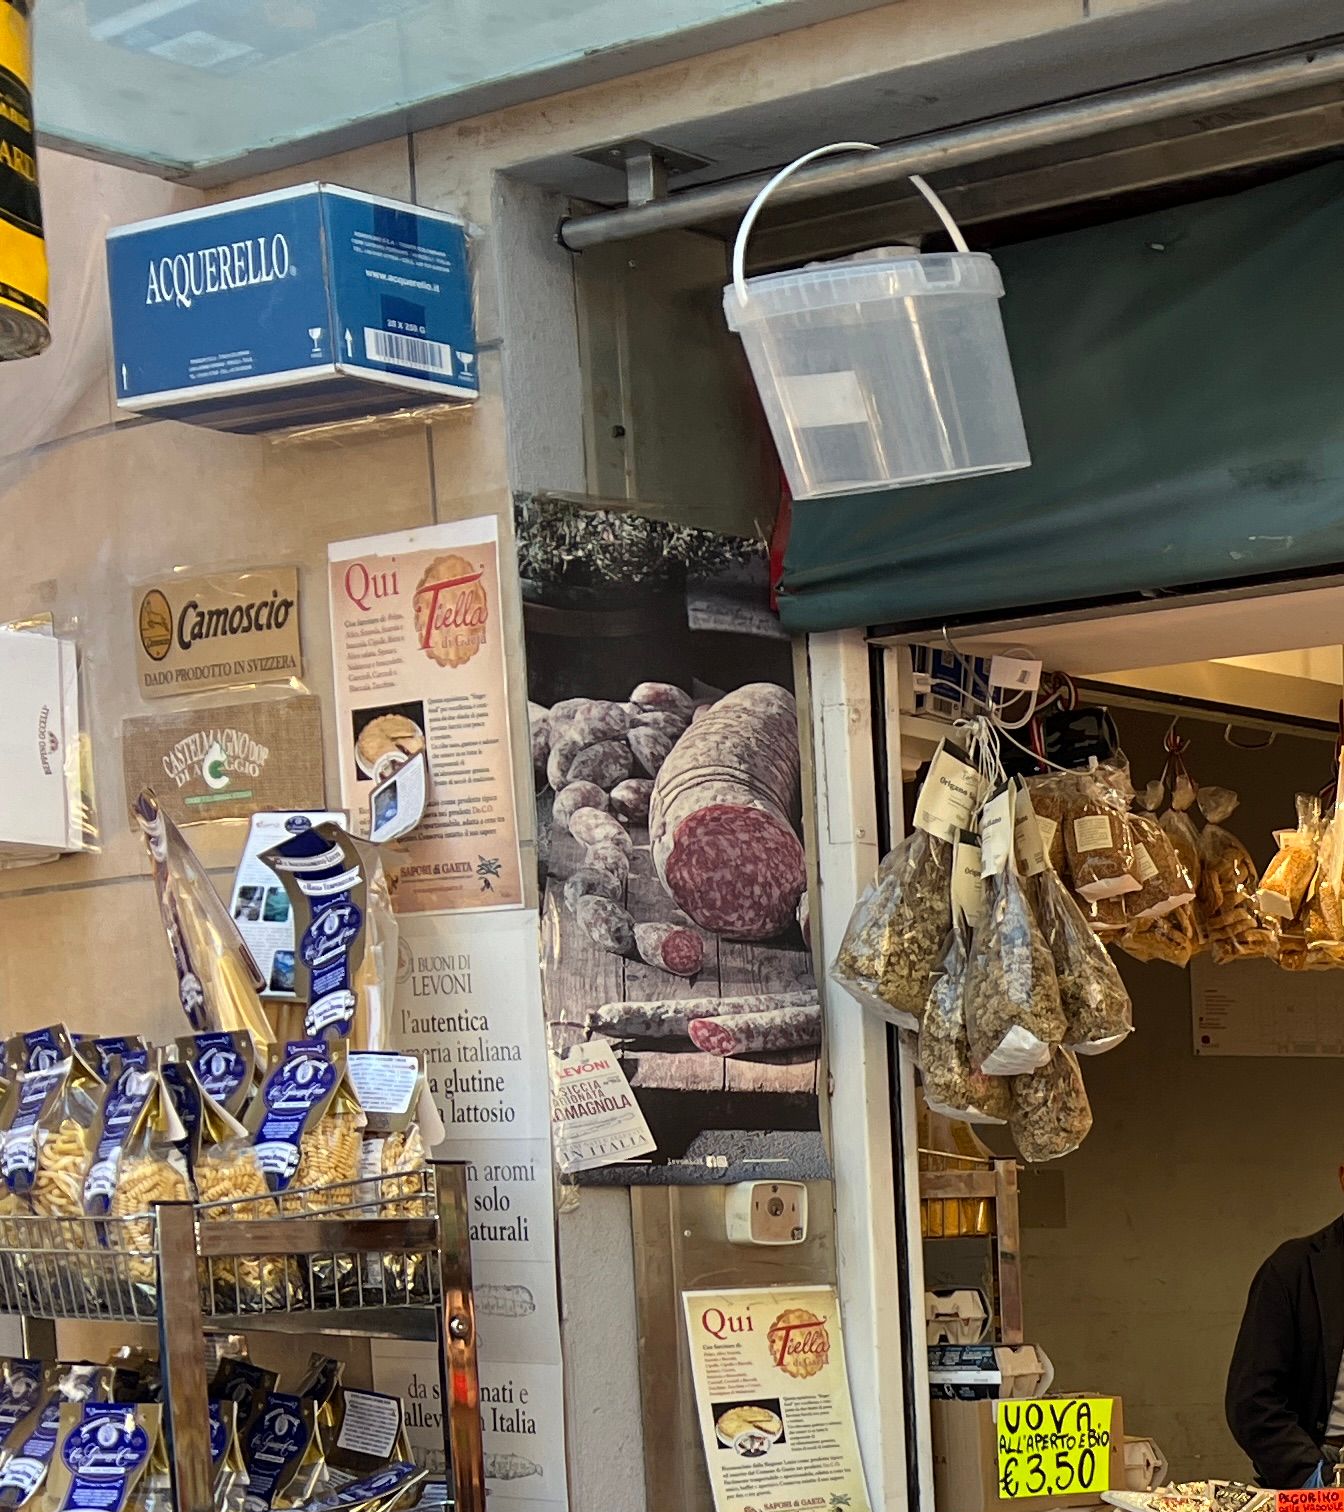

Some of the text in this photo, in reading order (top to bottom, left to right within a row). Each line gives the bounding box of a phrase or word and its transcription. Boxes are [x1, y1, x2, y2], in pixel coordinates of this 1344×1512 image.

[146, 233, 290, 308] ACQUERELLO
[345, 557, 400, 611] Qui
[177, 590, 294, 651] Camoscio
[416, 571, 488, 651] Tiella
[144, 655, 297, 688] DADO PRODOTTO IN SVIZZERA
[418, 955, 456, 974] BUONI
[457, 954, 471, 970] DI
[412, 973, 473, 997] LEVONI
[402, 1008, 489, 1035] l'autentica
[457, 1040, 522, 1062] italiana
[444, 1072, 505, 1099] glutine
[451, 1101, 516, 1124] lattosio
[552, 1094, 632, 1124] OMAGNOLA
[484, 1157, 536, 1182] aromi
[474, 1185, 510, 1212] solo
[470, 1215, 530, 1243] aturali
[702, 1307, 754, 1340] Qui
[768, 1316, 832, 1368] Tiella
[407, 1370, 428, 1400] da
[491, 1407, 537, 1435] Italia
[1003, 1401, 1092, 1434] UOVA
[1000, 1432, 1077, 1455] ALL'APERTO
[1086, 1422, 1110, 1448] BIO
